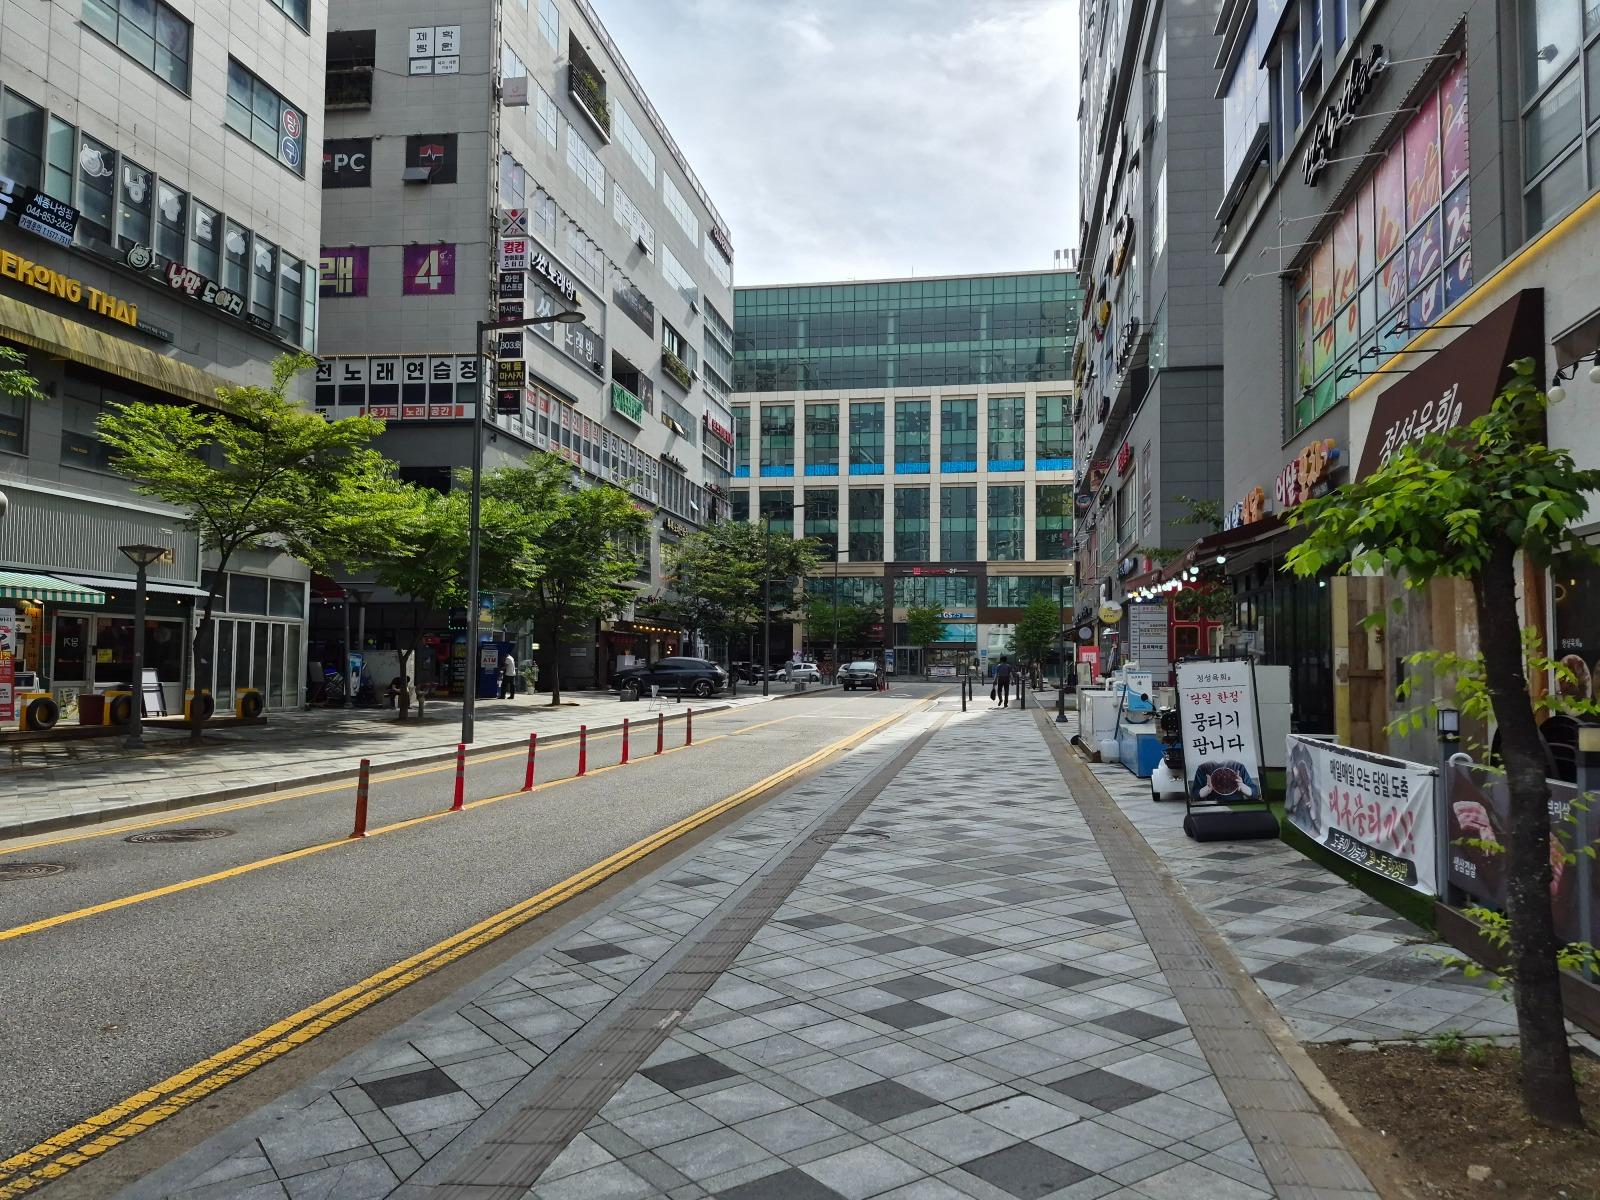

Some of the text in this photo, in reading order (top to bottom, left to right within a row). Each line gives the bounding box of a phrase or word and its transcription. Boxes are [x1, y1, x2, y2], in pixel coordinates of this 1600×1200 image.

[284, 113, 299, 161] 당구
[334, 153, 366, 173] PC
[319, 250, 441, 293] 래 4
[169, 262, 245, 316] 낭만 도야지
[501, 371, 526, 380] 마사지
[405, 406, 425, 416] 노래
[430, 407, 450, 416] 공간
[943, 611, 961, 619] GS25
[1197, 673, 1227, 683] 정성육회
[1191, 710, 1240, 732] 뭉티기
[1192, 734, 1245, 756] 팝니다
[1330, 758, 1409, 803] 매일매일 오는 당일 도축
[1453, 856, 1477, 880] 생삼겹살
